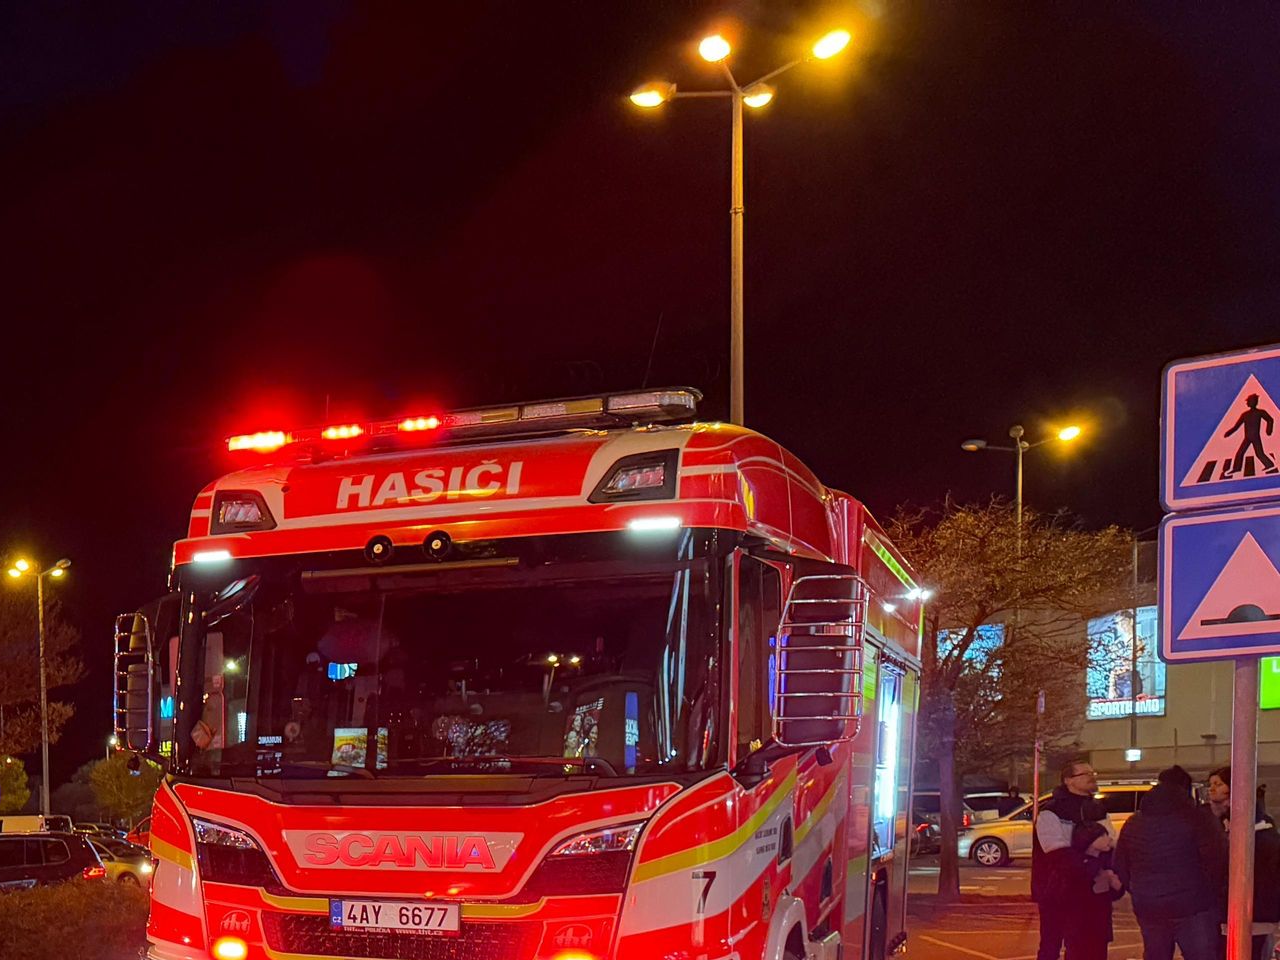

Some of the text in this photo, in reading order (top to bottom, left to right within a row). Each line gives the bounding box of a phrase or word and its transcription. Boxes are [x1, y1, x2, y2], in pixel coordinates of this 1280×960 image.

[335, 458, 524, 509] HASIČI
[1090, 699, 1160, 716] SPORTIIMO
[304, 832, 496, 869] SCANIA
[691, 870, 717, 914] 7
[347, 904, 449, 928] 4AY 6677
